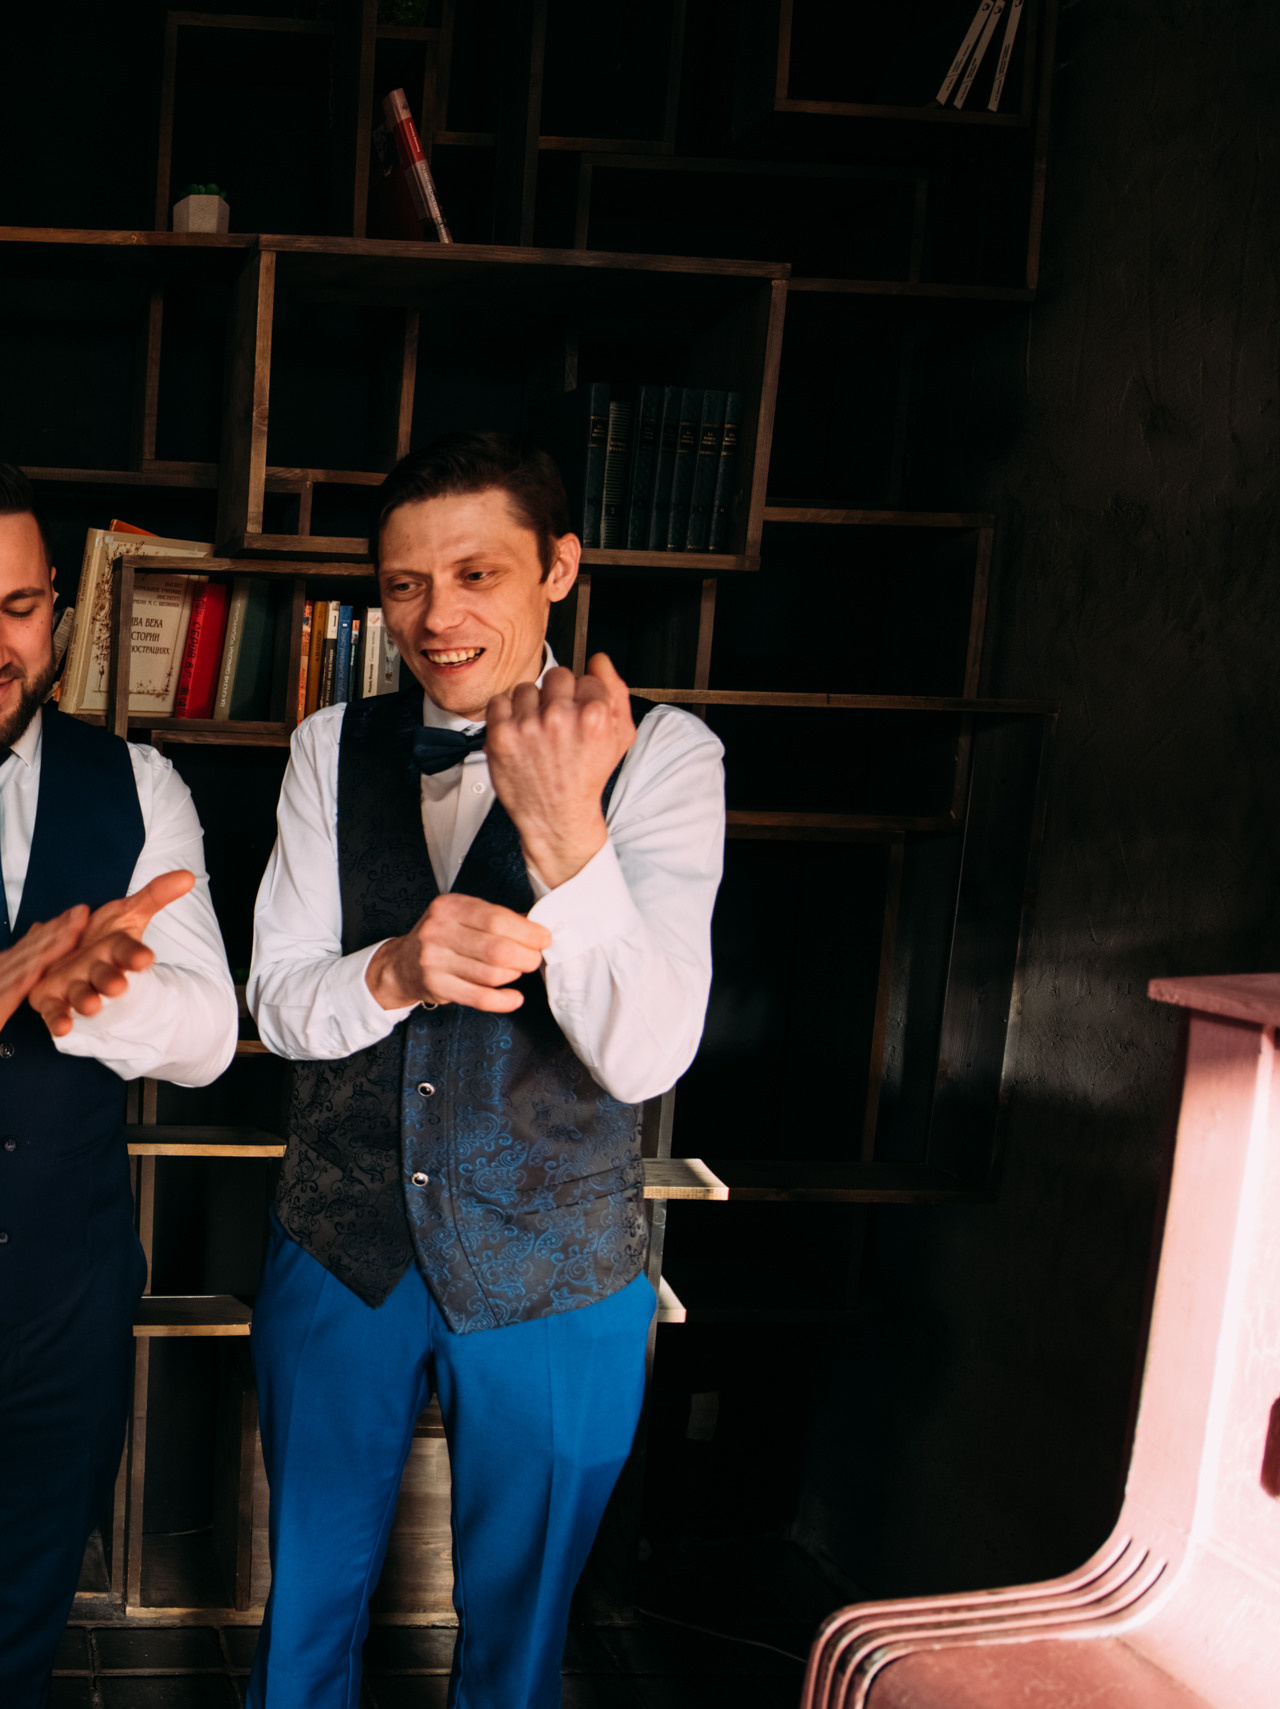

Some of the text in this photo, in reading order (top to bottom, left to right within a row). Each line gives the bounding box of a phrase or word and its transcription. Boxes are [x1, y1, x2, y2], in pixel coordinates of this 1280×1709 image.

[145, 618, 163, 628] ВЕКА
[130, 631, 160, 642] СТОРИИ
[131, 645, 170, 655] ЮСТРАЦИЯХ
